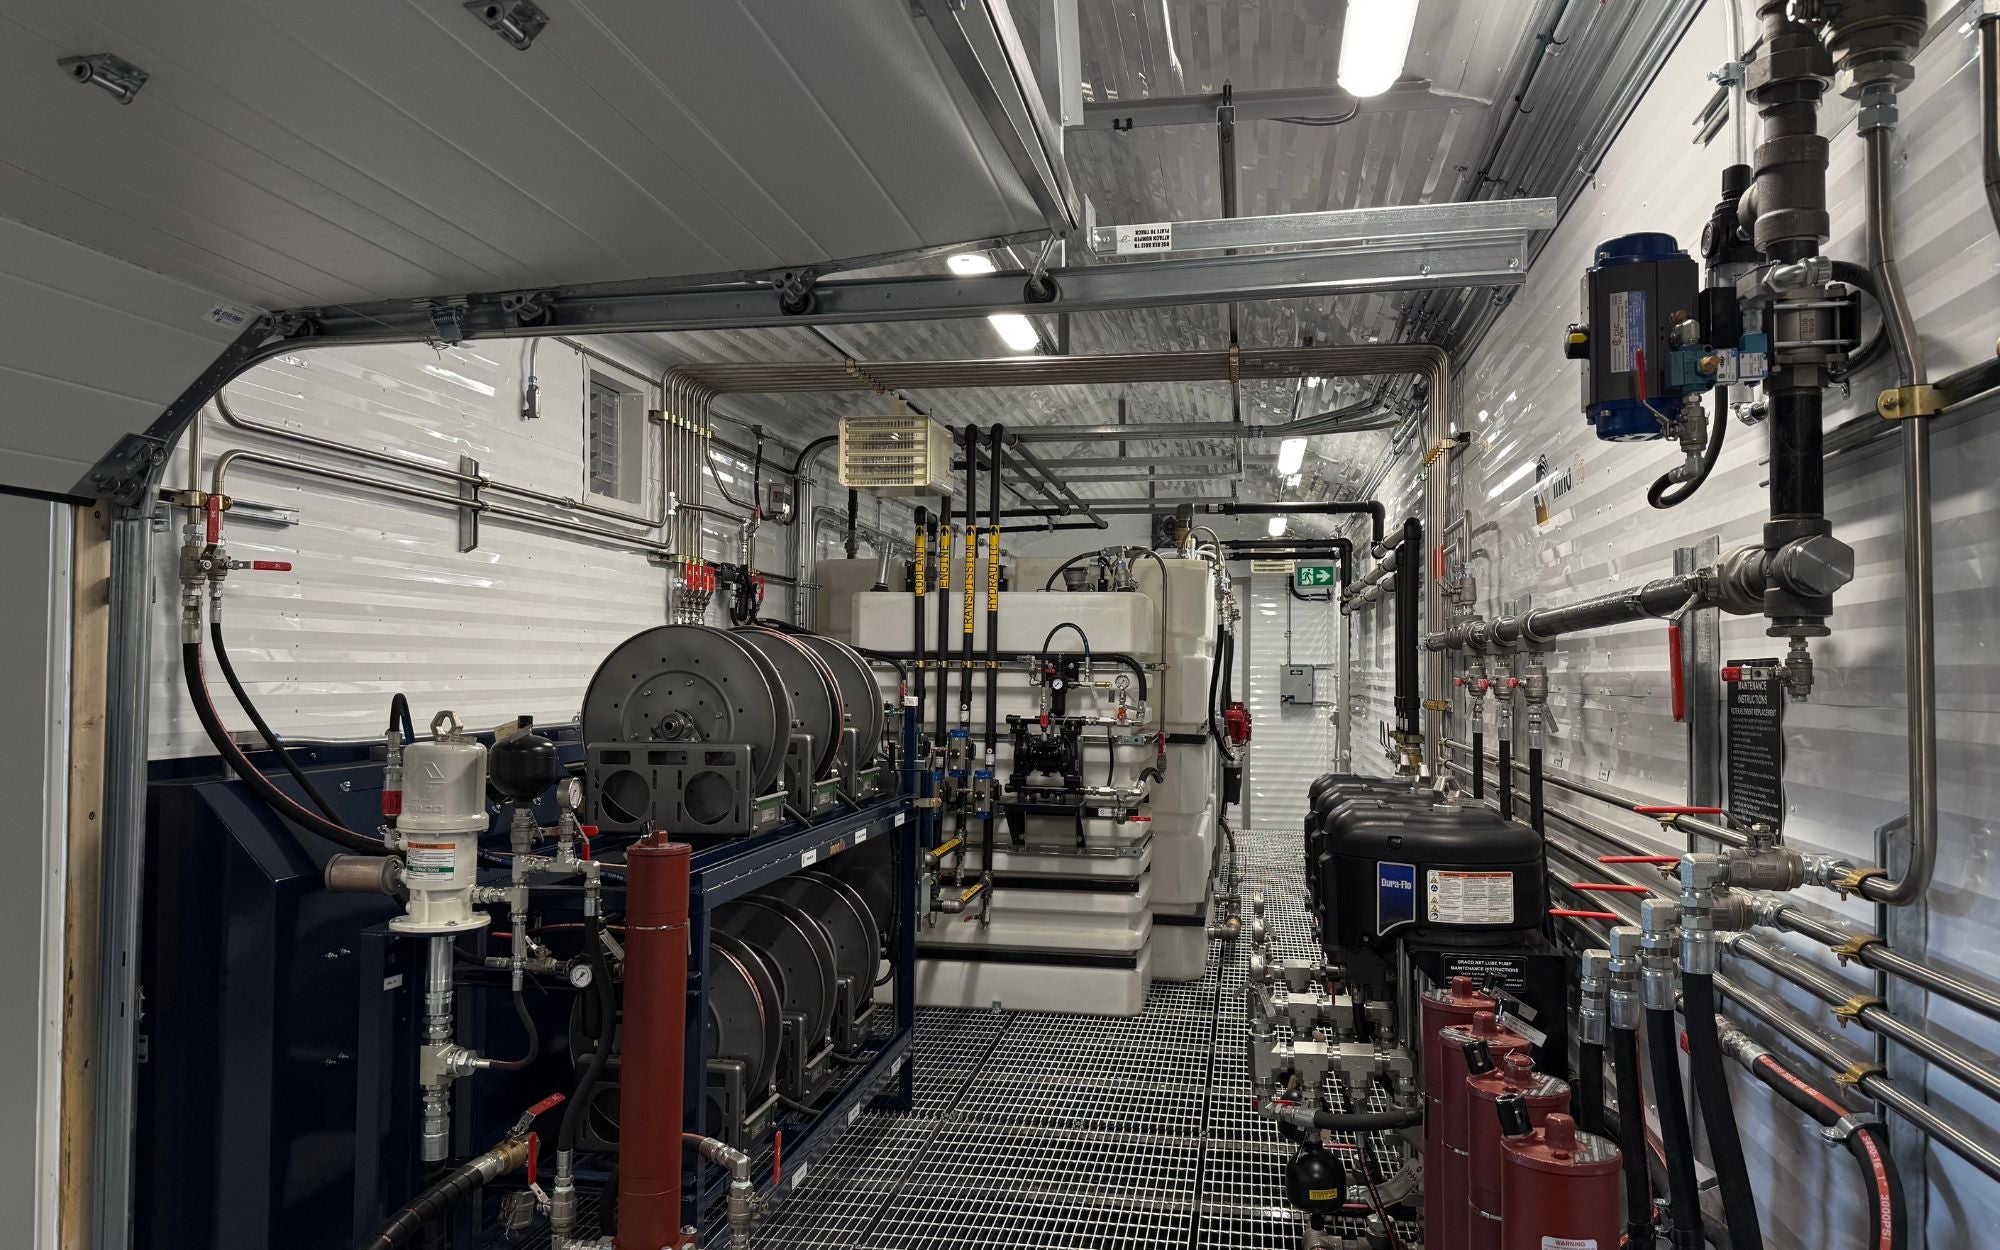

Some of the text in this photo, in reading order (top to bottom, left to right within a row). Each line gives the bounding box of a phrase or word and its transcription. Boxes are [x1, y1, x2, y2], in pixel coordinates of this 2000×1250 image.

[915, 546, 924, 595] COOLANT
[940, 544, 949, 588] ENGINE
[963, 544, 975, 631] TRANSMISSION
[987, 543, 998, 610] HYDRAULIC
[1737, 681, 1768, 690] MAINTENANCE
[1737, 694, 1768, 705] INSTRUCTIONS
[1381, 878, 1412, 890] Dura-Flo
[1880, 1193, 1892, 1241] 3000PSI
[1554, 1239, 1586, 1247] WARNING
